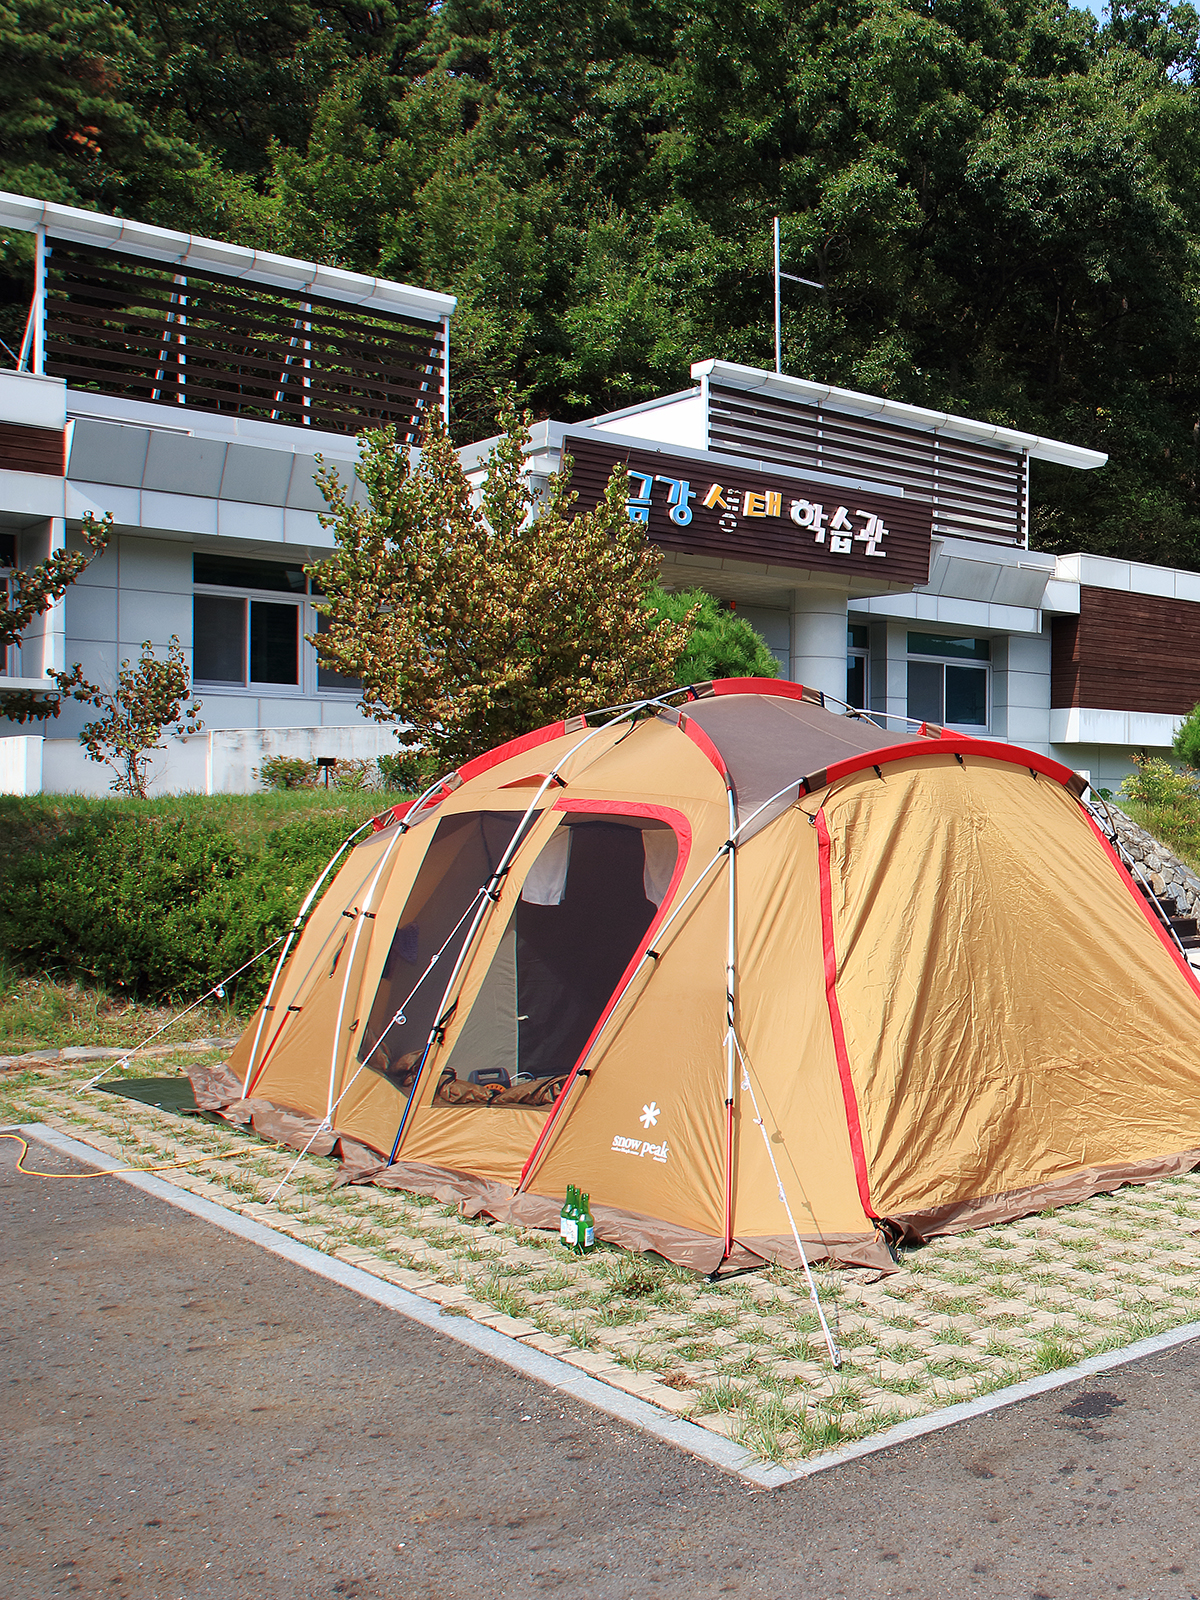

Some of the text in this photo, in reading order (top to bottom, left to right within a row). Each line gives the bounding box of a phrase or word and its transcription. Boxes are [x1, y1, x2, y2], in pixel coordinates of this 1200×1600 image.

[625, 469, 697, 527] 금강
[789, 498, 890, 557] 학습관
[612, 1134, 643, 1151] snow
[639, 1140, 670, 1159] peak
